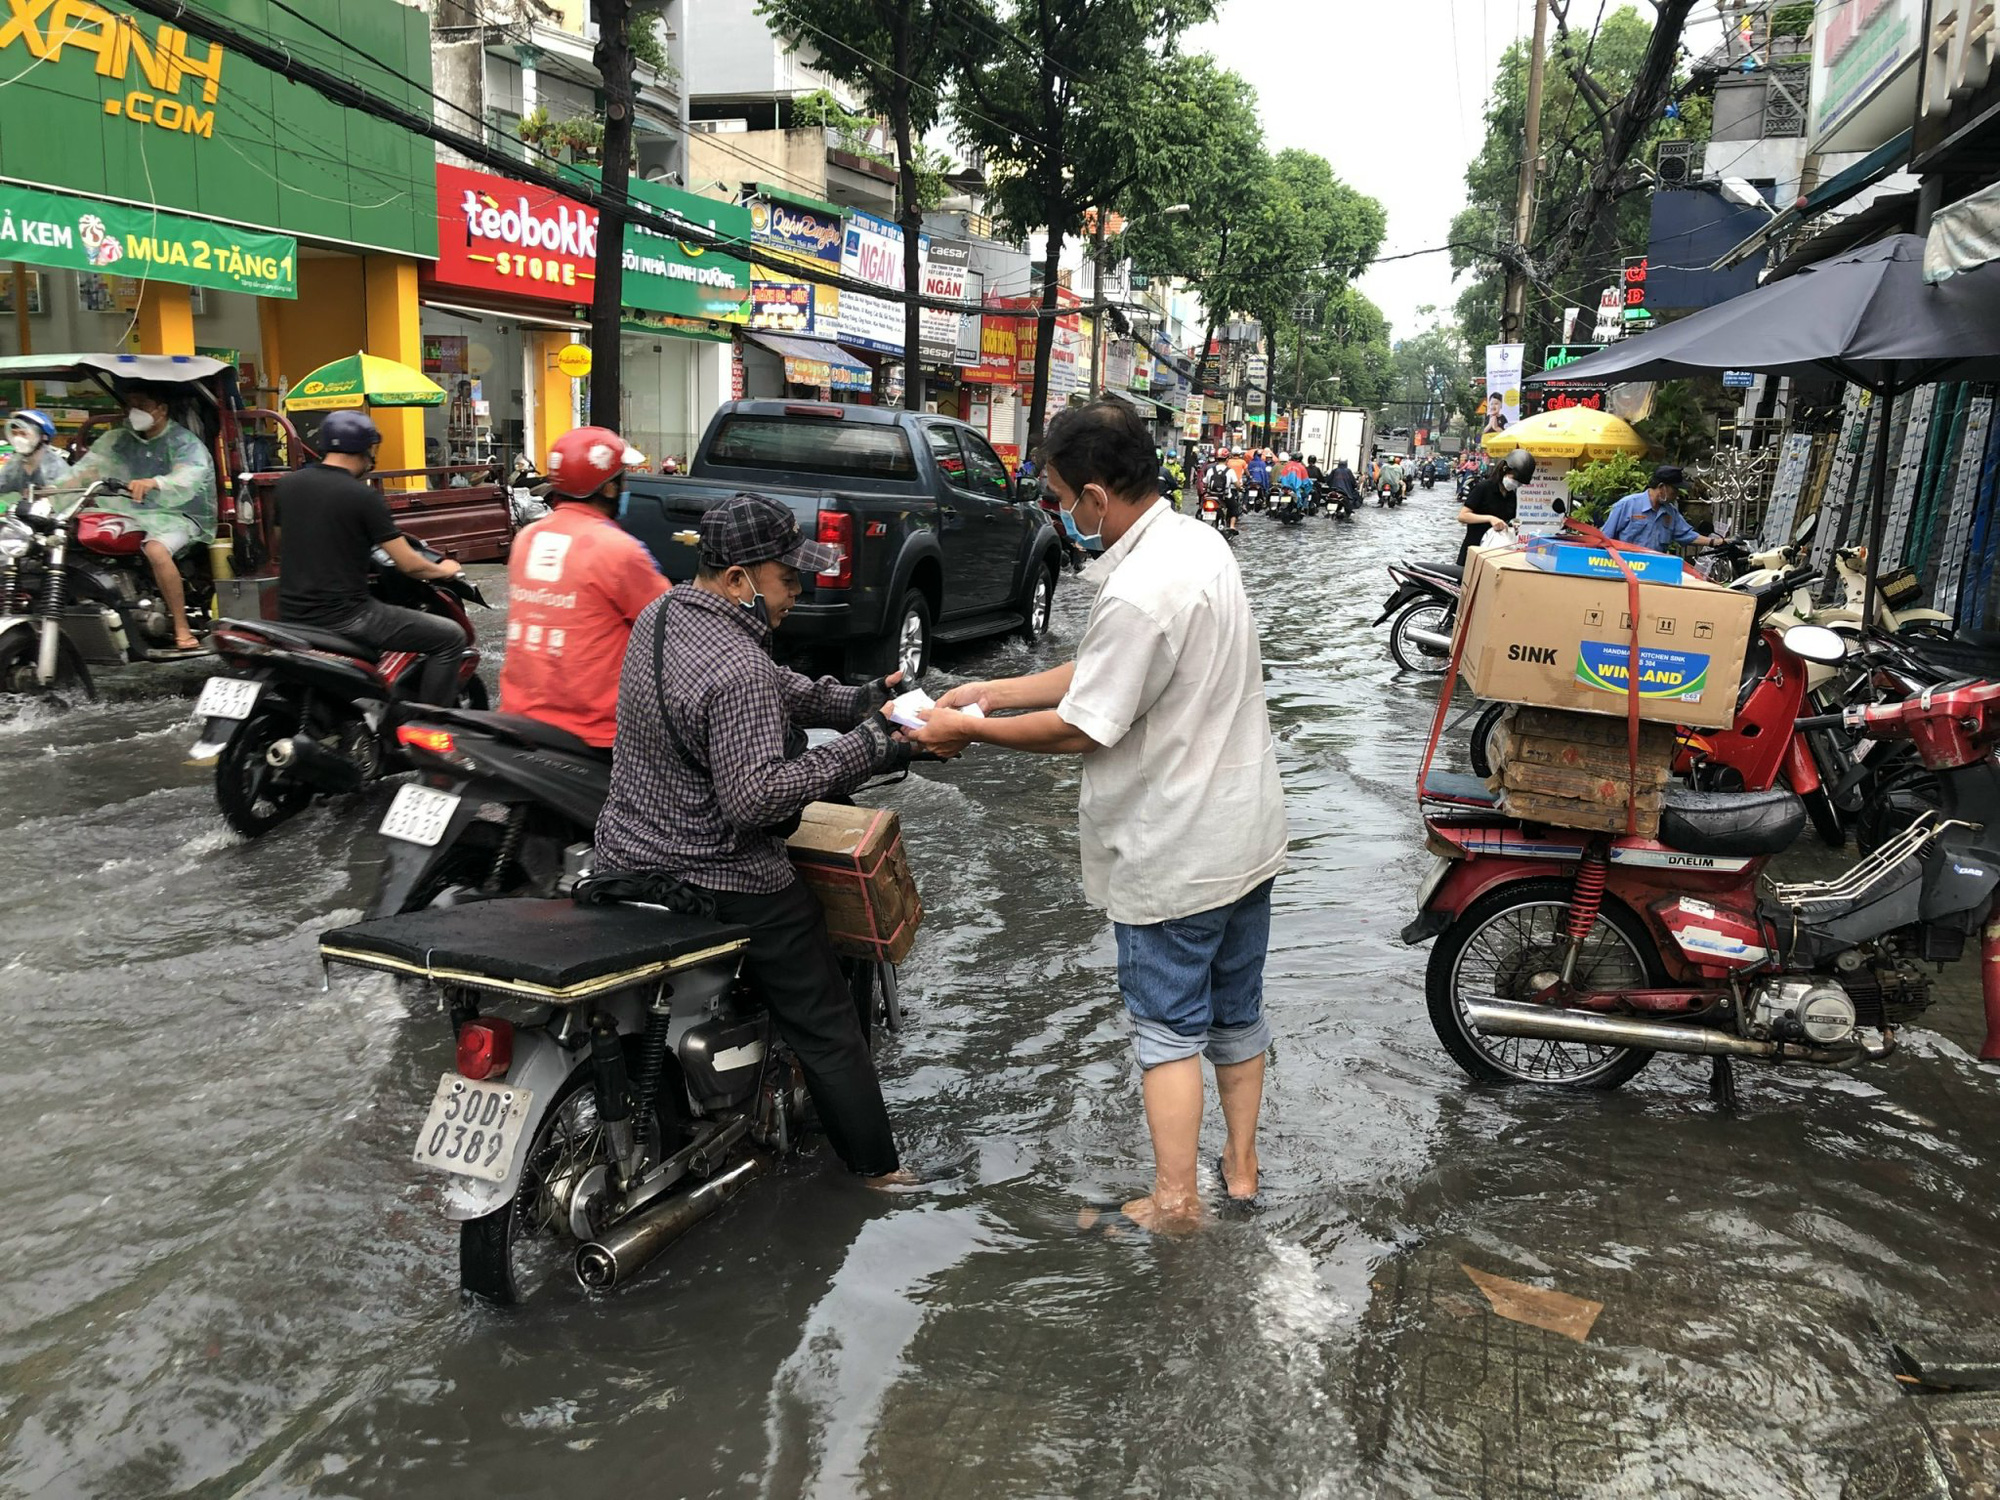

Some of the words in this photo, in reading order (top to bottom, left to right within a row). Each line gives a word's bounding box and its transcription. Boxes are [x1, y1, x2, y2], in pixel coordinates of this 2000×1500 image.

[105, 90, 214, 138] .COM
[21, 219, 73, 250] KEM
[127, 234, 188, 267] MUA
[192, 241, 212, 270] 2
[214, 245, 278, 281] TẶNG
[280, 255, 292, 282] 1
[859, 241, 897, 286] NGÂN
[930, 246, 968, 259] caesar
[496, 252, 576, 287] STORE
[641, 254, 667, 277] NHÀ
[667, 262, 698, 283] DINH
[698, 266, 736, 289] DƯỠNG
[926, 278, 962, 298] NGÂN
[866, 521, 888, 536] Z71
[1507, 644, 1558, 666] SINK
[1640, 652, 1669, 660] KITCHEN
[1670, 655, 1686, 663] SINK
